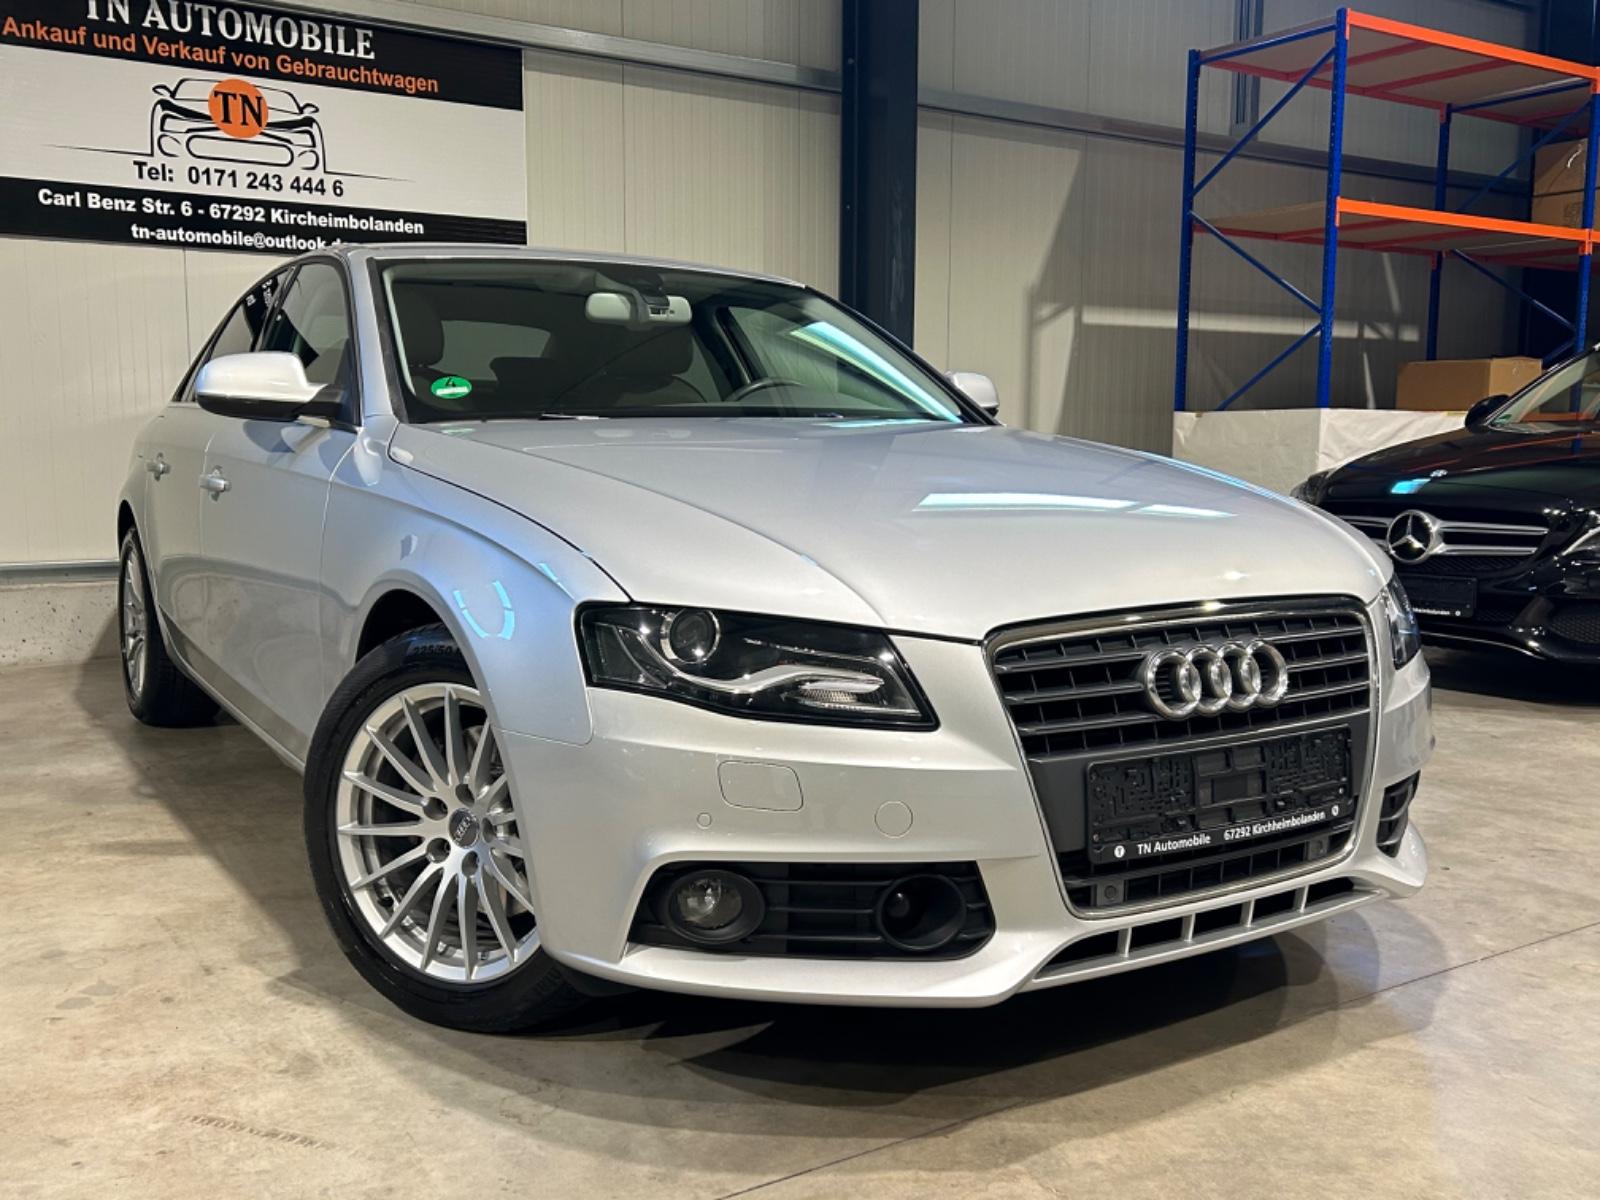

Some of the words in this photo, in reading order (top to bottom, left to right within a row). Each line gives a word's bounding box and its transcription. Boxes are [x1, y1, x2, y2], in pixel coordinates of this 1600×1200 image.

[142, 0, 376, 60] AUTOMOBILE
[2, 16, 87, 46] Ankauf
[93, 32, 136, 53] und
[142, 35, 226, 65] Verkauf
[231, 51, 270, 71] von
[276, 54, 439, 94] Gebrauchtwagen
[213, 90, 263, 128] TN
[133, 160, 174, 182] Tel:
[187, 166, 238, 188] 0171
[246, 172, 283, 192] 243
[290, 176, 326, 196] 444
[332, 180, 344, 197] 6
[38, 188, 81, 207] Carl
[87, 192, 136, 212] Benz
[142, 198, 175, 215] Str.
[181, 201, 193, 217] 6
[209, 203, 266, 222] 67292
[271, 208, 424, 234] Kircheimbolanden
[1137, 842, 1152, 855] TN
[1153, 833, 1211, 853] Automobile
[1224, 826, 1251, 841] 67292
[1252, 811, 1326, 835] Kirchheimbolanden
